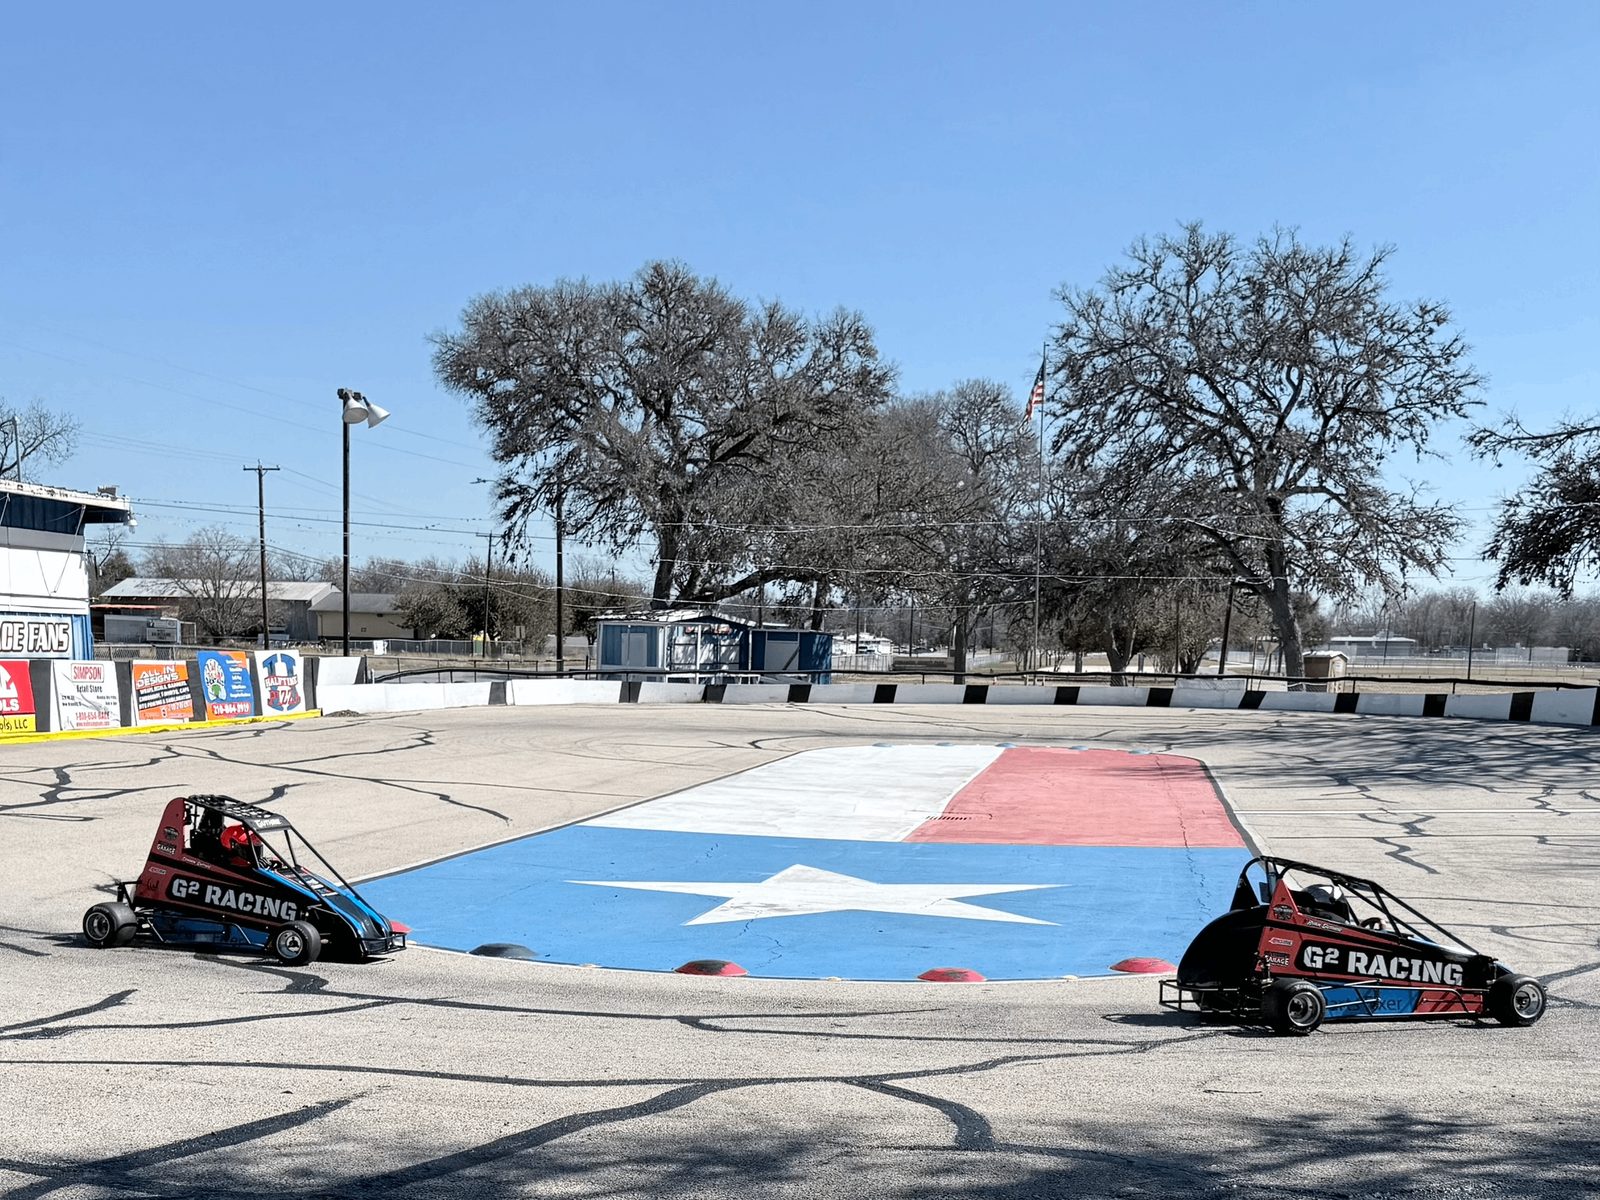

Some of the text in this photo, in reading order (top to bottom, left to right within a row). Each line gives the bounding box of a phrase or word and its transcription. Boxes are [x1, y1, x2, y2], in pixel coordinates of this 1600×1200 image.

[0, 621, 70, 652] CE FANS
[73, 665, 102, 680] SIMPSON
[140, 664, 176, 678] ALL IN
[136, 671, 179, 688] DESIGNS
[0, 699, 20, 711] LS
[269, 690, 301, 706] PIZZA
[14, 719, 28, 729] LLC
[204, 885, 298, 921] RACING
[1347, 951, 1464, 986] RACING
